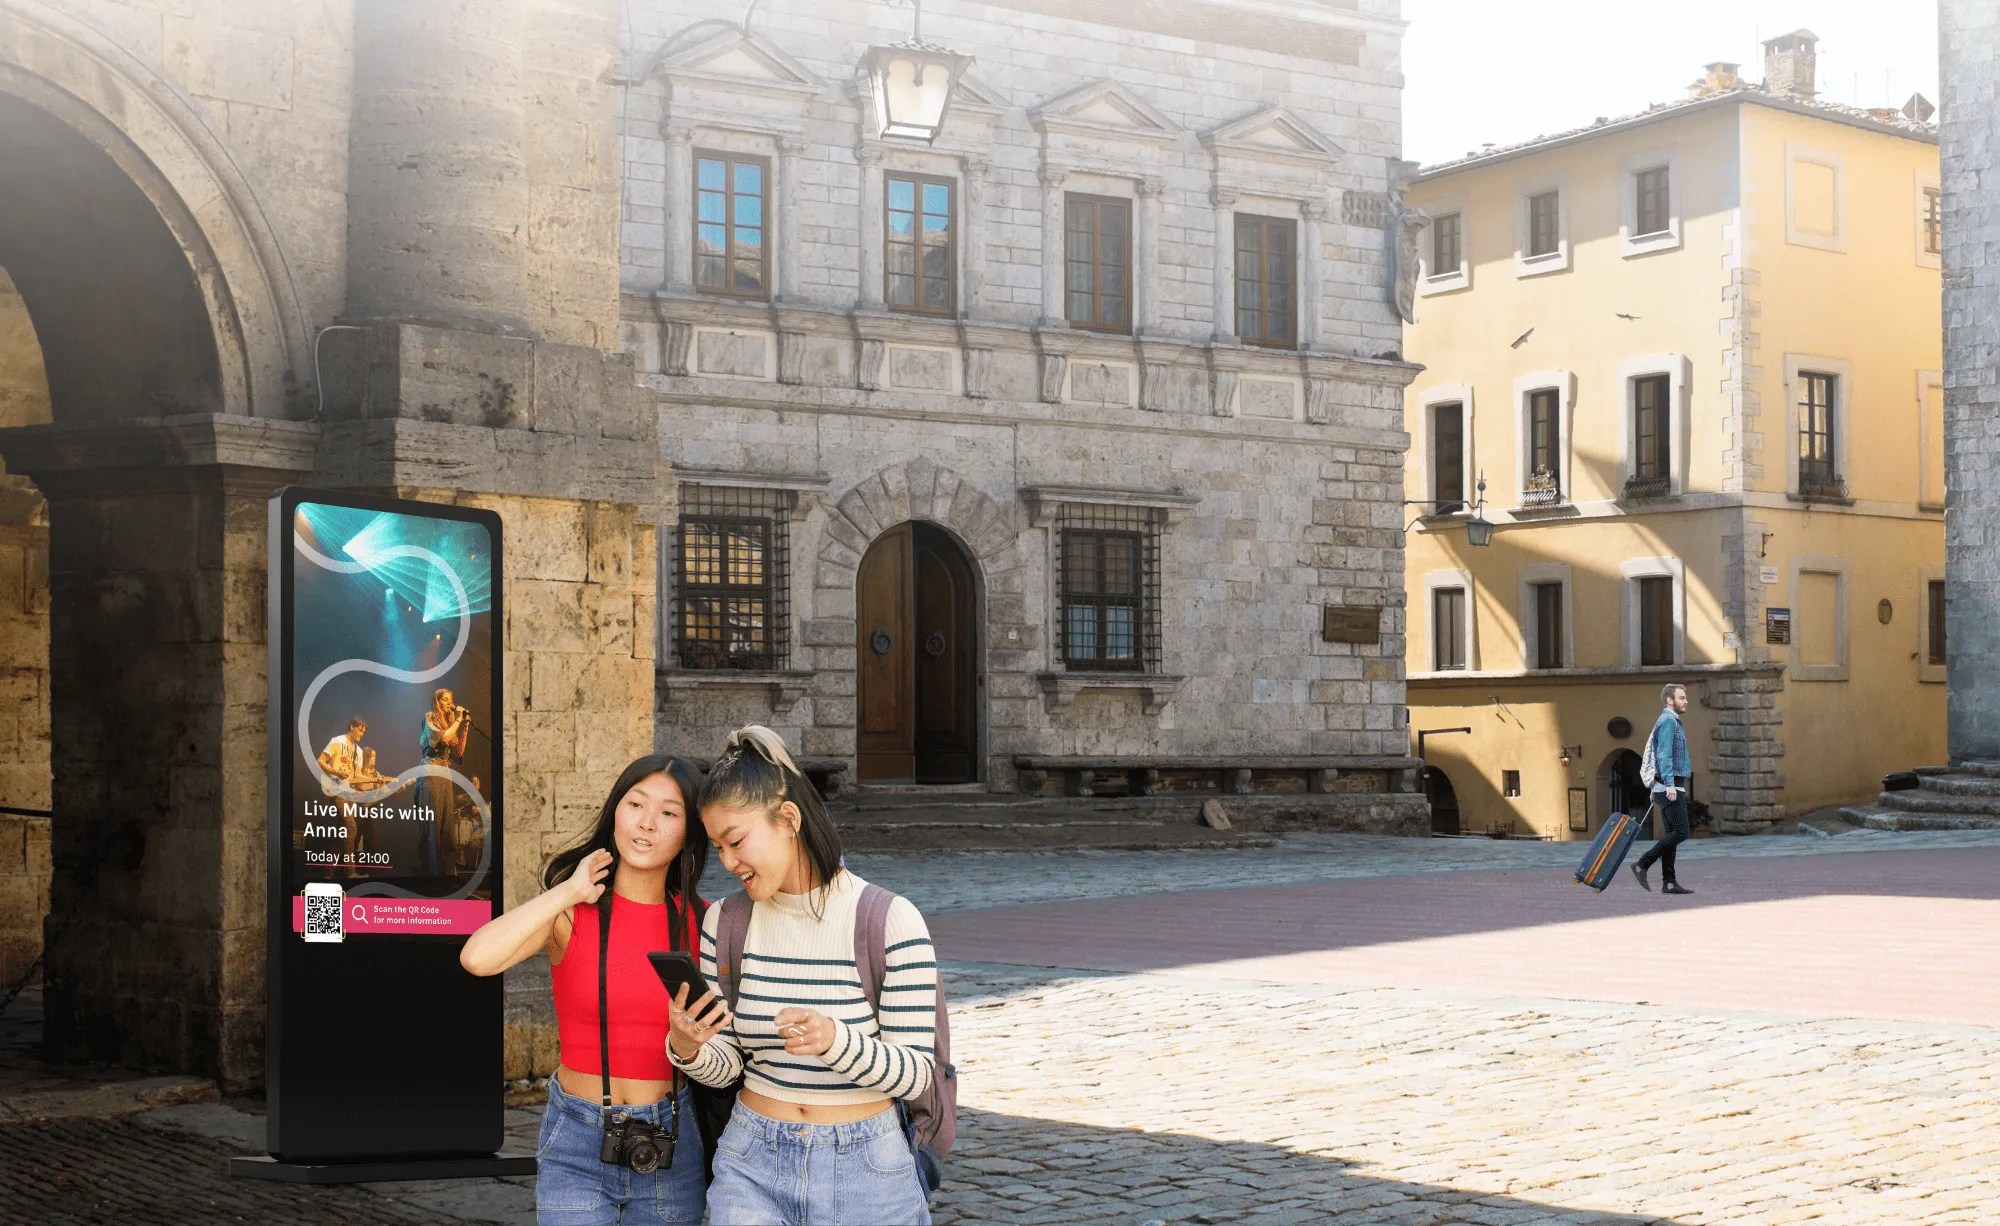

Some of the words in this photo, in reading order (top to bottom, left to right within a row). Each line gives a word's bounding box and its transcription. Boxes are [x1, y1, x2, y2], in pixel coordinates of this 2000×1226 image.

[304, 800, 338, 817] Live
[343, 802, 394, 820] Music
[398, 804, 435, 821] with
[303, 822, 348, 839] Anna
[304, 850, 340, 866] Today
[343, 853, 356, 863] at
[358, 852, 390, 864] 21:00
[373, 905, 393, 913] Scan
[394, 906, 407, 914] the
[408, 906, 419, 915] QR
[420, 906, 440, 914] Code
[373, 916, 385, 924] for
[407, 916, 452, 925] information
